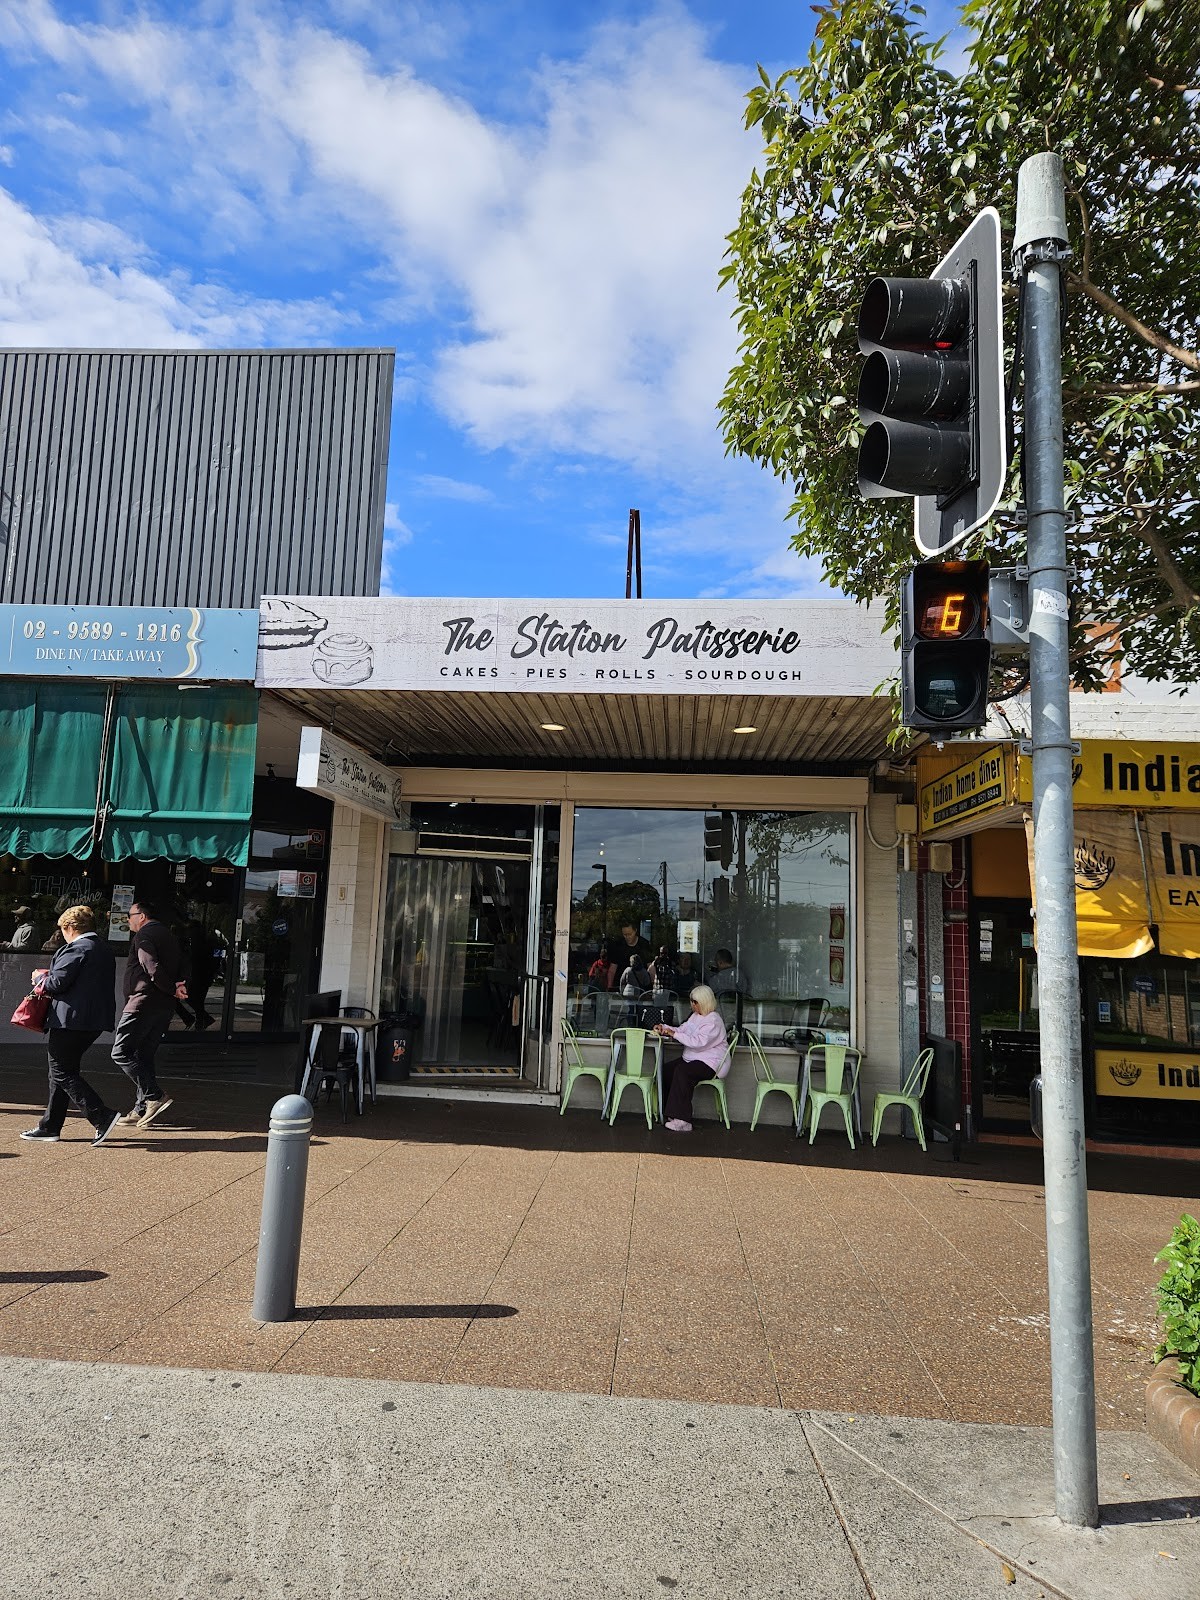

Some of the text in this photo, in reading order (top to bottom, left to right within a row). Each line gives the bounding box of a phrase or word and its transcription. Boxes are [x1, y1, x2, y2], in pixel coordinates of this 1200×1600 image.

[940, 595, 965, 631] 6
[23, 620, 46, 639] 02
[67, 621, 114, 641] 9589
[136, 622, 182, 642] 1216
[442, 612, 801, 660] The Station Patisserie
[35, 648, 66, 661] DINE
[69, 648, 82, 661] IN
[90, 649, 124, 662] TAKE
[126, 650, 165, 663] AWAY
[440, 666, 499, 678] CAKES
[526, 668, 567, 679] PIES
[595, 669, 655, 680] ROLLS
[685, 669, 802, 681] SOURDOUGH
[933, 784, 953, 808] Indian
[956, 773, 976, 797] home
[979, 757, 1001, 785] diner
[30, 874, 92, 897] THAI
[1168, 889, 1200, 907] EA
[1157, 1063, 1200, 1088] Ind
